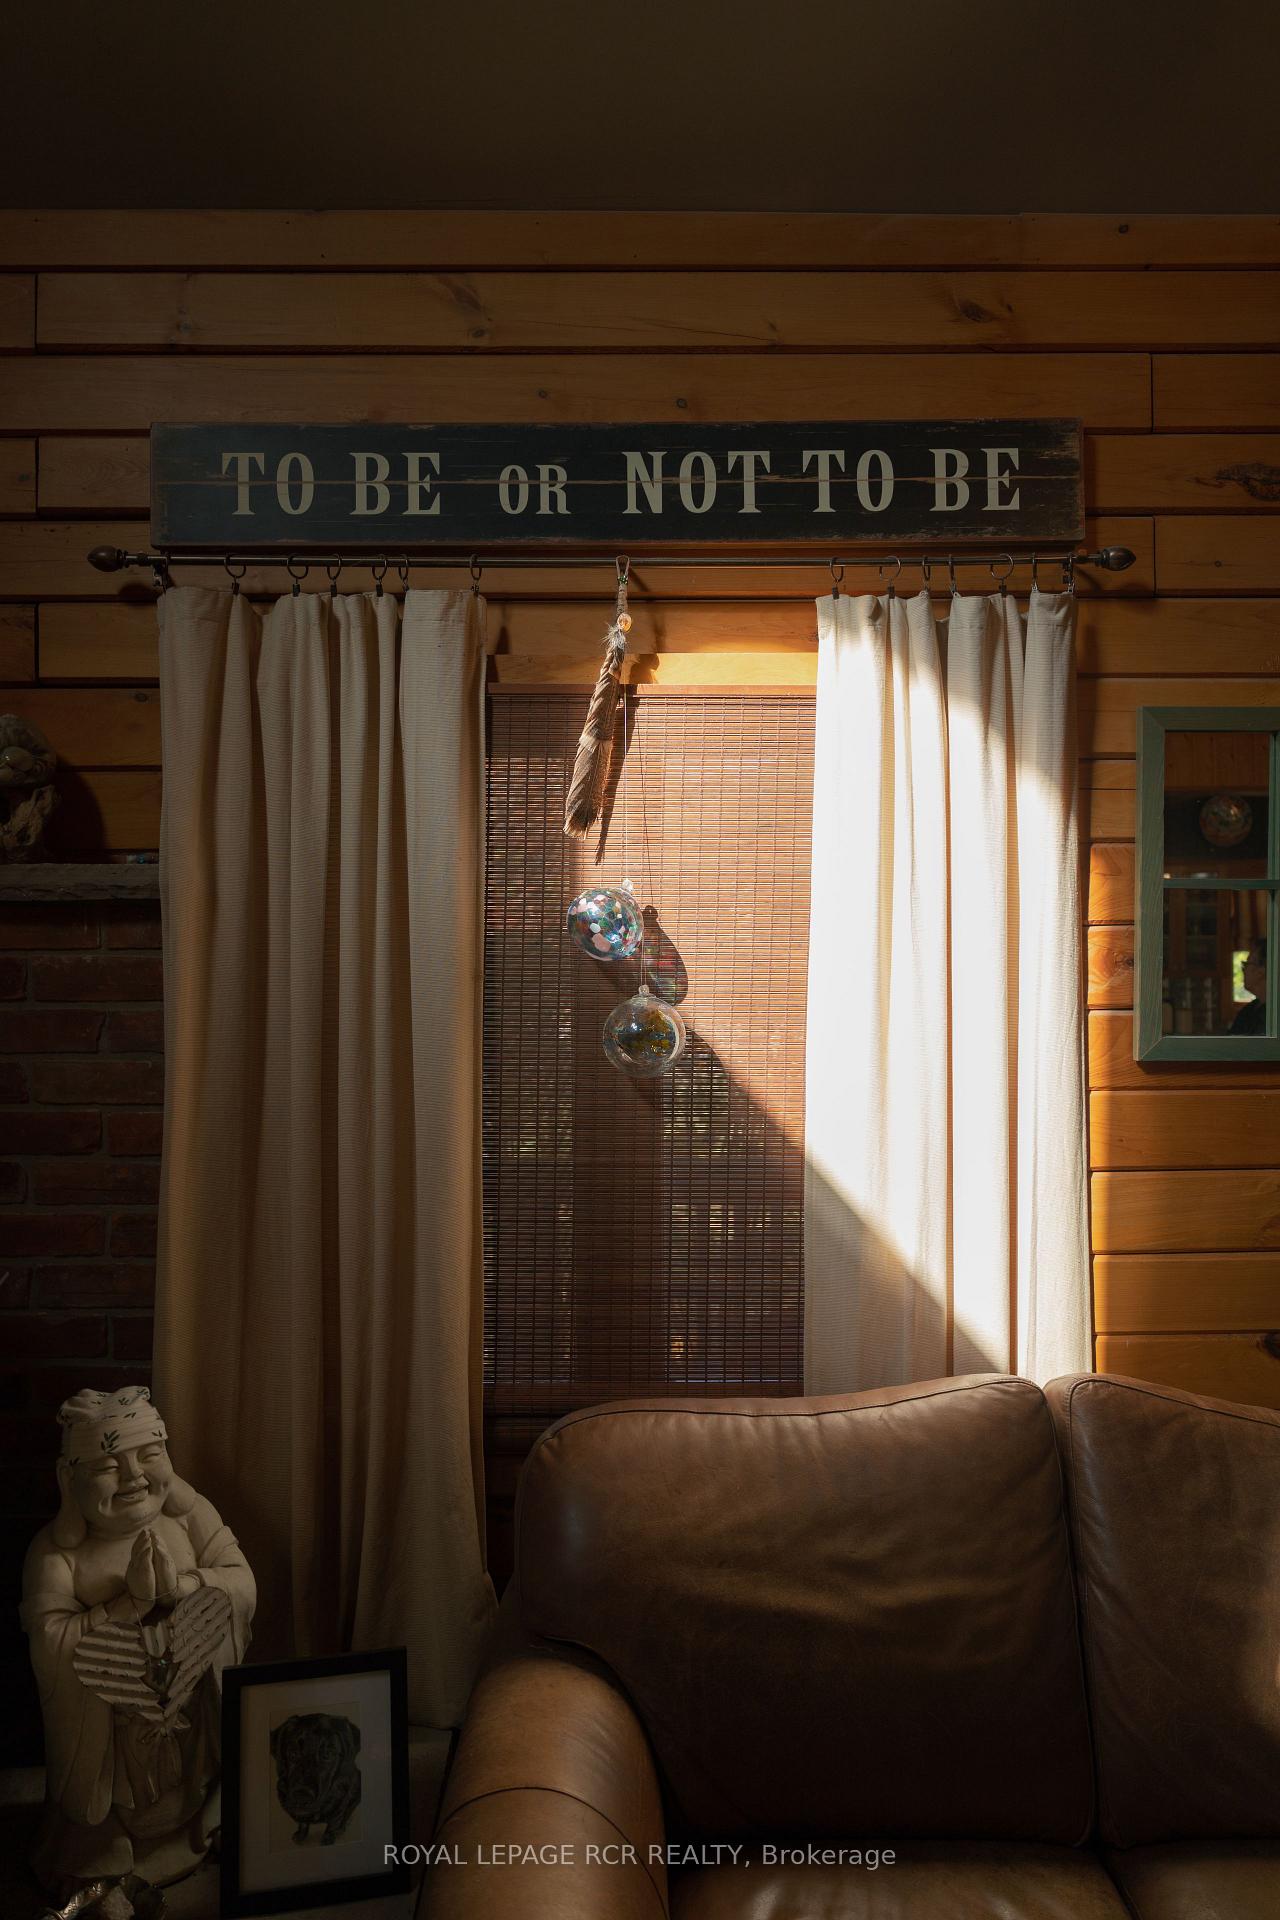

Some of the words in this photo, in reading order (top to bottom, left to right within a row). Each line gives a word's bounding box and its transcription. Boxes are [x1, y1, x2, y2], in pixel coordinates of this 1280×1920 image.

[221, 452, 315, 516] TO
[349, 452, 441, 516] BE
[498, 464, 572, 515] OR
[621, 450, 771, 515] NOT
[802, 449, 895, 513] TO
[928, 447, 1021, 512] BE
